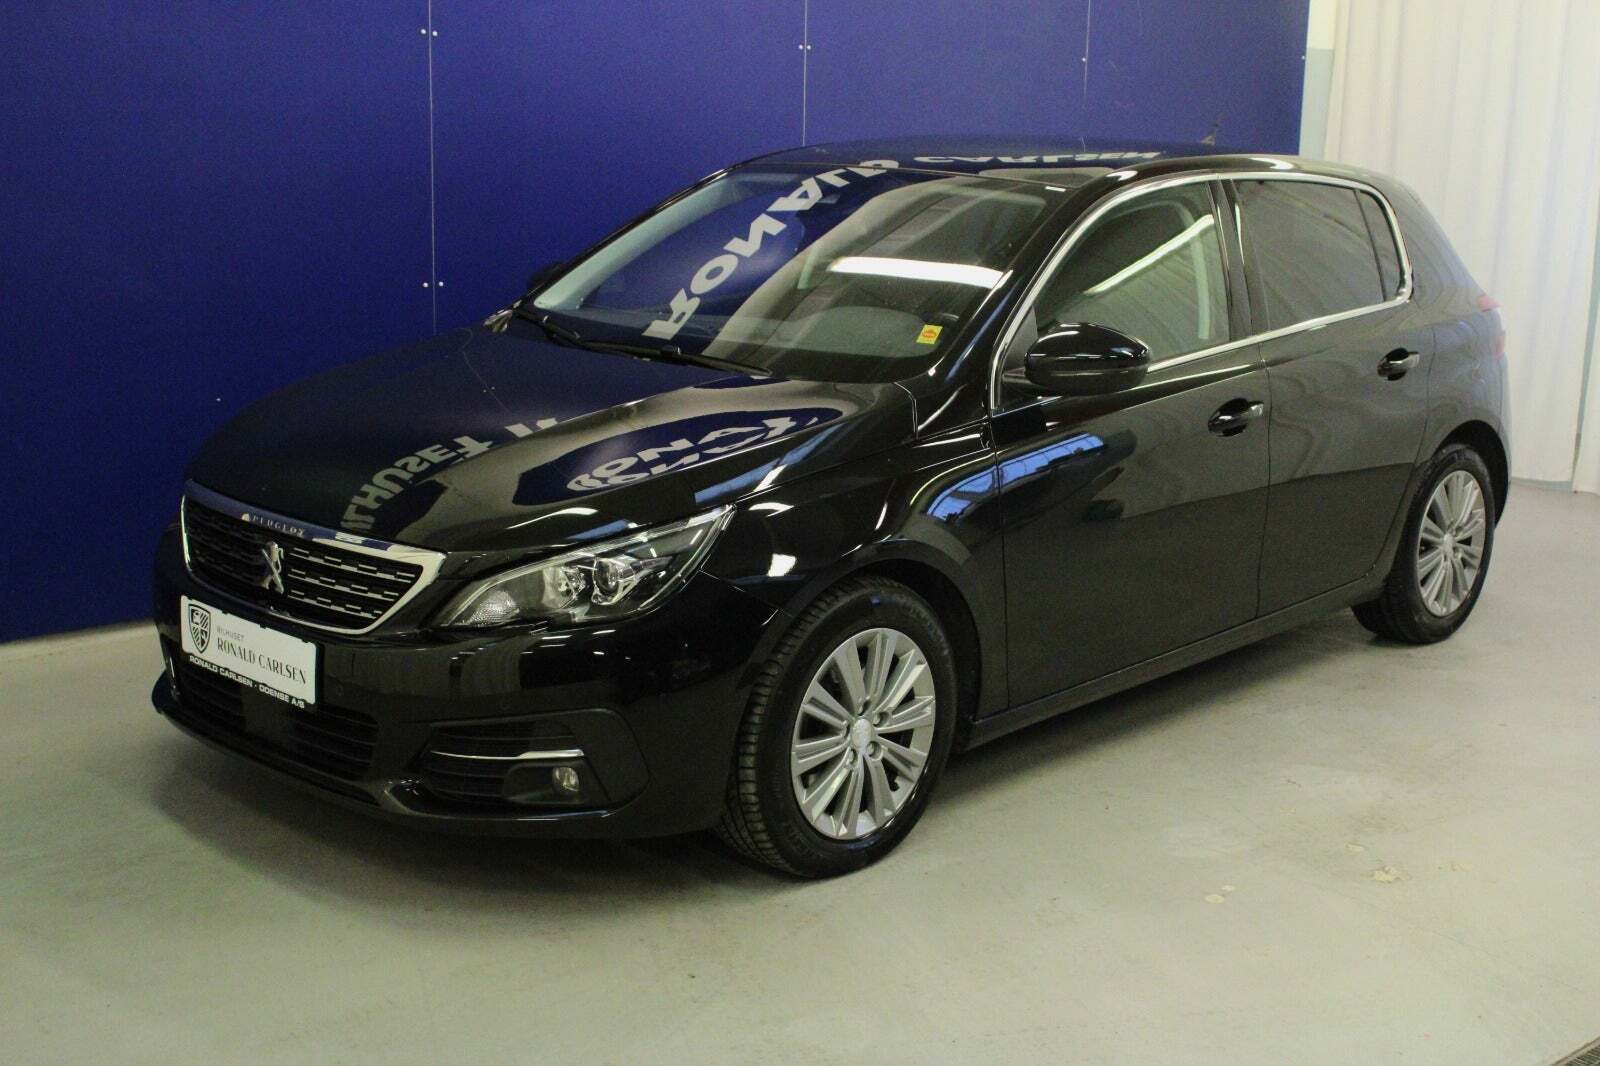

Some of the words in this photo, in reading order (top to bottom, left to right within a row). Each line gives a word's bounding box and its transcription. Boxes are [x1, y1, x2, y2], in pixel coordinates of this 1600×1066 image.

[189, 655, 218, 673] RONALD
[219, 667, 253, 688] CARLSEN
[259, 684, 290, 703] ODENSE
[291, 697, 305, 709] A/S
[217, 637, 256, 664] RONALD
[258, 654, 306, 684] CARLSEN
